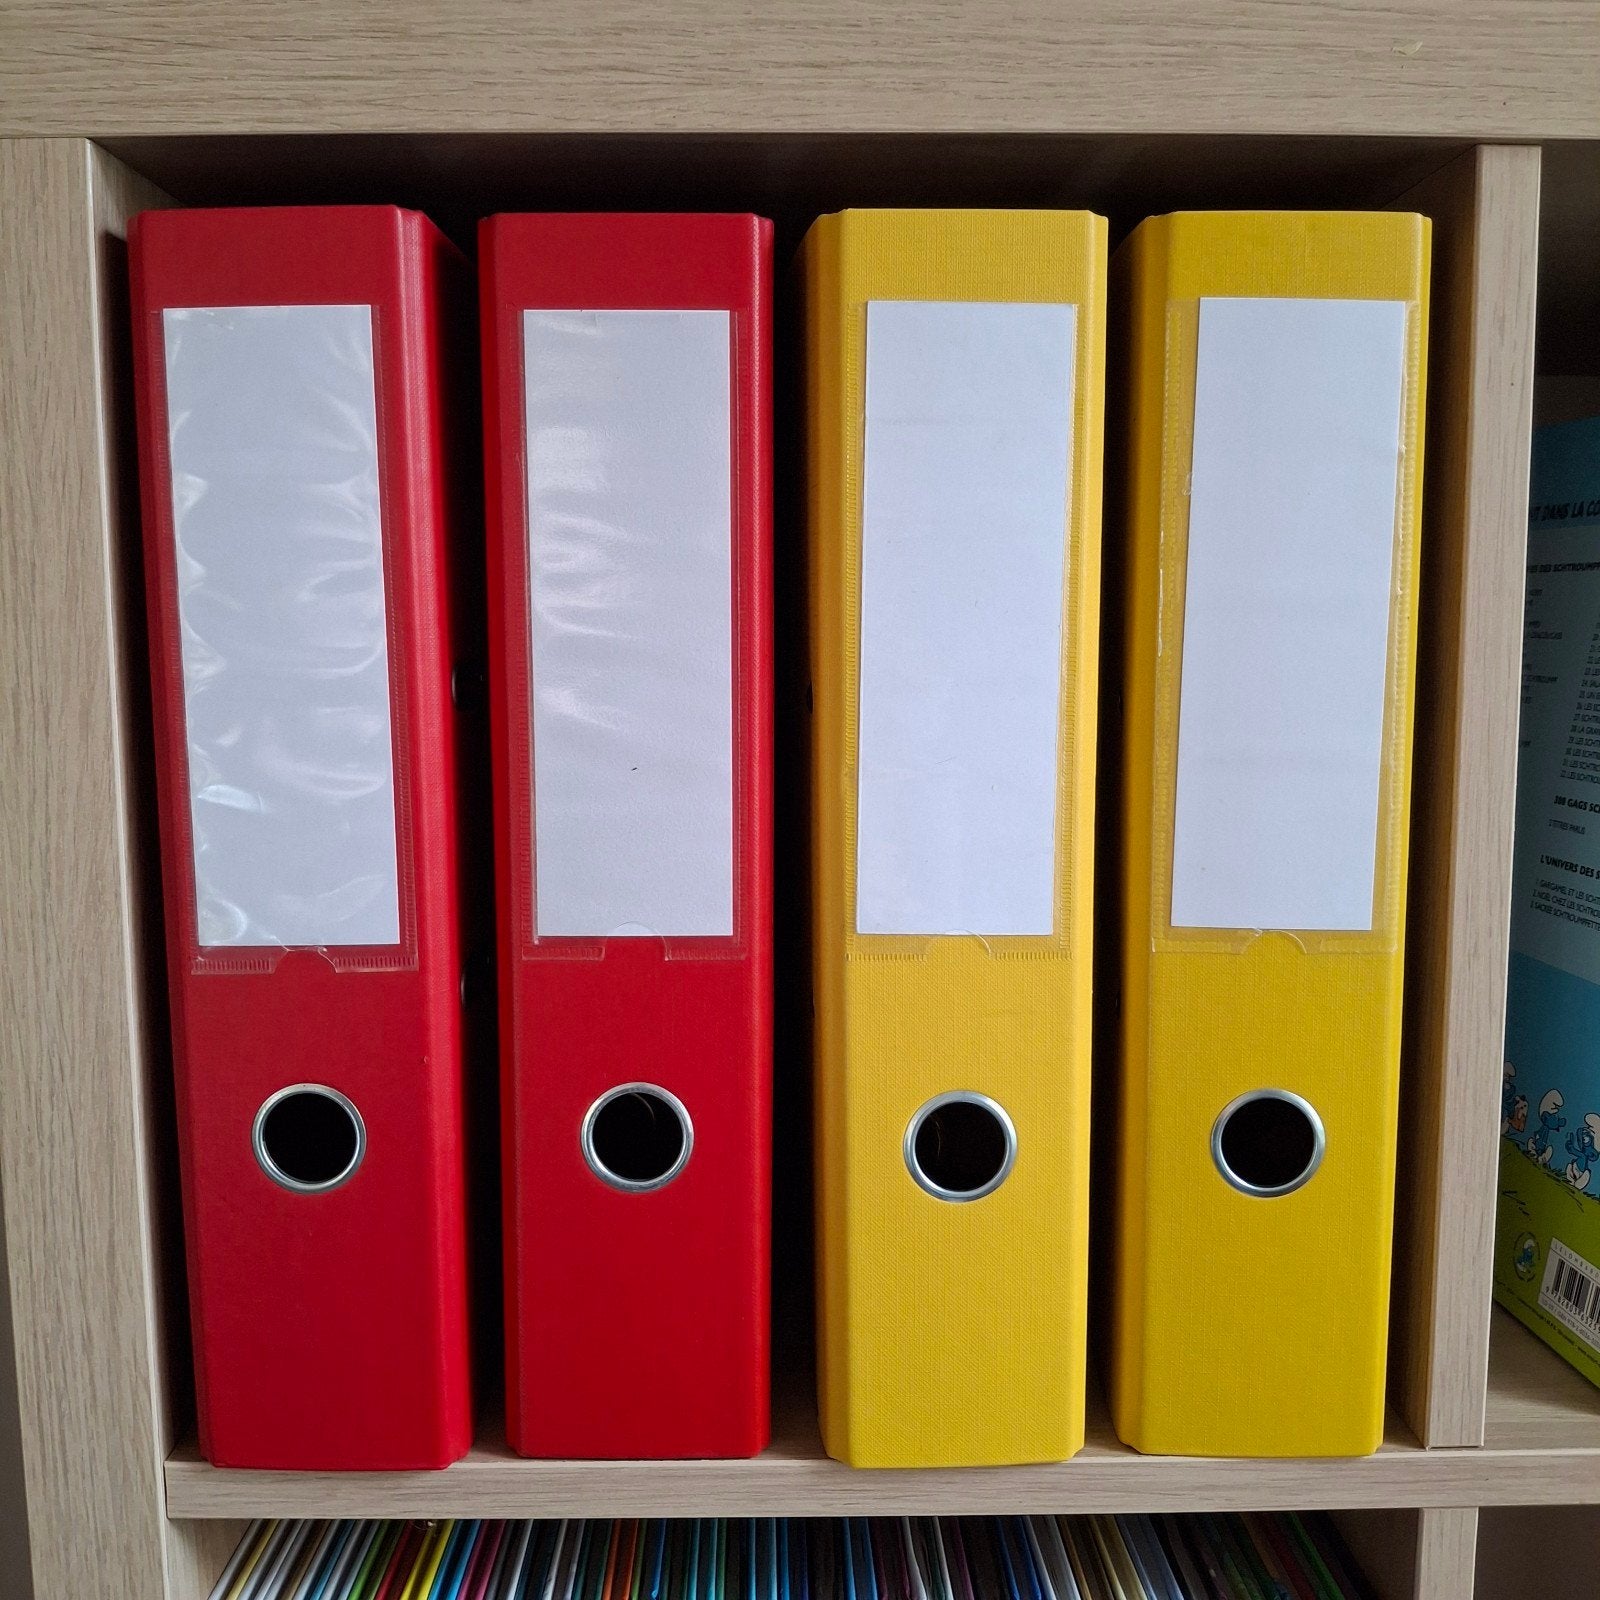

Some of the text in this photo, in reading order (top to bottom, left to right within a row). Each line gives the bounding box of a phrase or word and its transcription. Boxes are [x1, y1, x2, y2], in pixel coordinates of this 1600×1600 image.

[1541, 502, 1570, 522] DANS
[1571, 501, 1584, 518] LA
[1567, 798, 1587, 811] GAGS
[1588, 803, 1600, 814] SC
[1540, 854, 1578, 873] L'UNIVERS
[1579, 865, 1594, 878] DES
